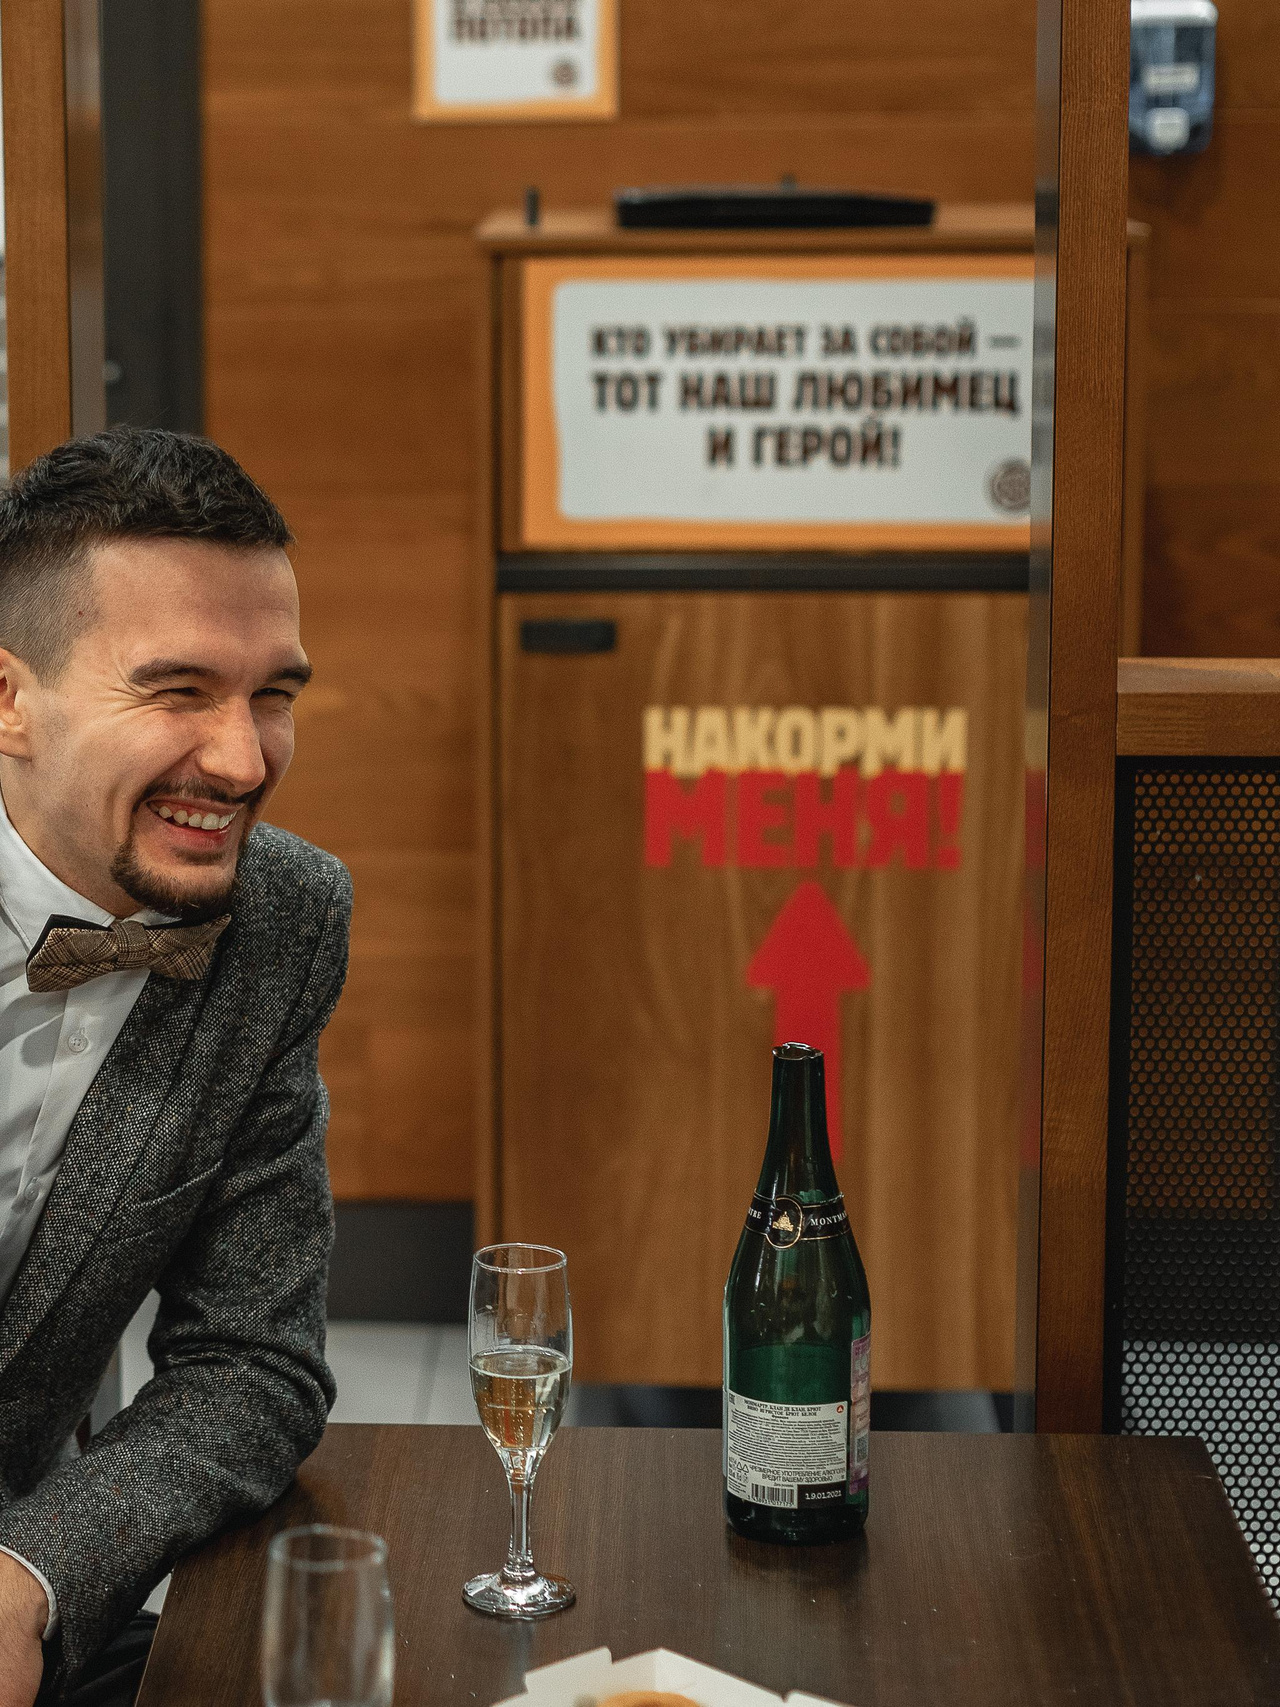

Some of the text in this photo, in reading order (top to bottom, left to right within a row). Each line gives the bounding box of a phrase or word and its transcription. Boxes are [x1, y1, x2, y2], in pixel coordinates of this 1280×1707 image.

[591, 325, 652, 359] КТО
[665, 325, 808, 359] УБИРАЕТ
[821, 325, 858, 359] ЗА
[870, 317, 978, 359] СОБОЙ
[592, 370, 1019, 420] ТОТ НАШ ЛЮБИМЕЦ
[706, 416, 902, 469] И ГЕРОЙ!
[644, 706, 967, 780] НАКОРМИ
[644, 768, 964, 868] МЕНЯ!
